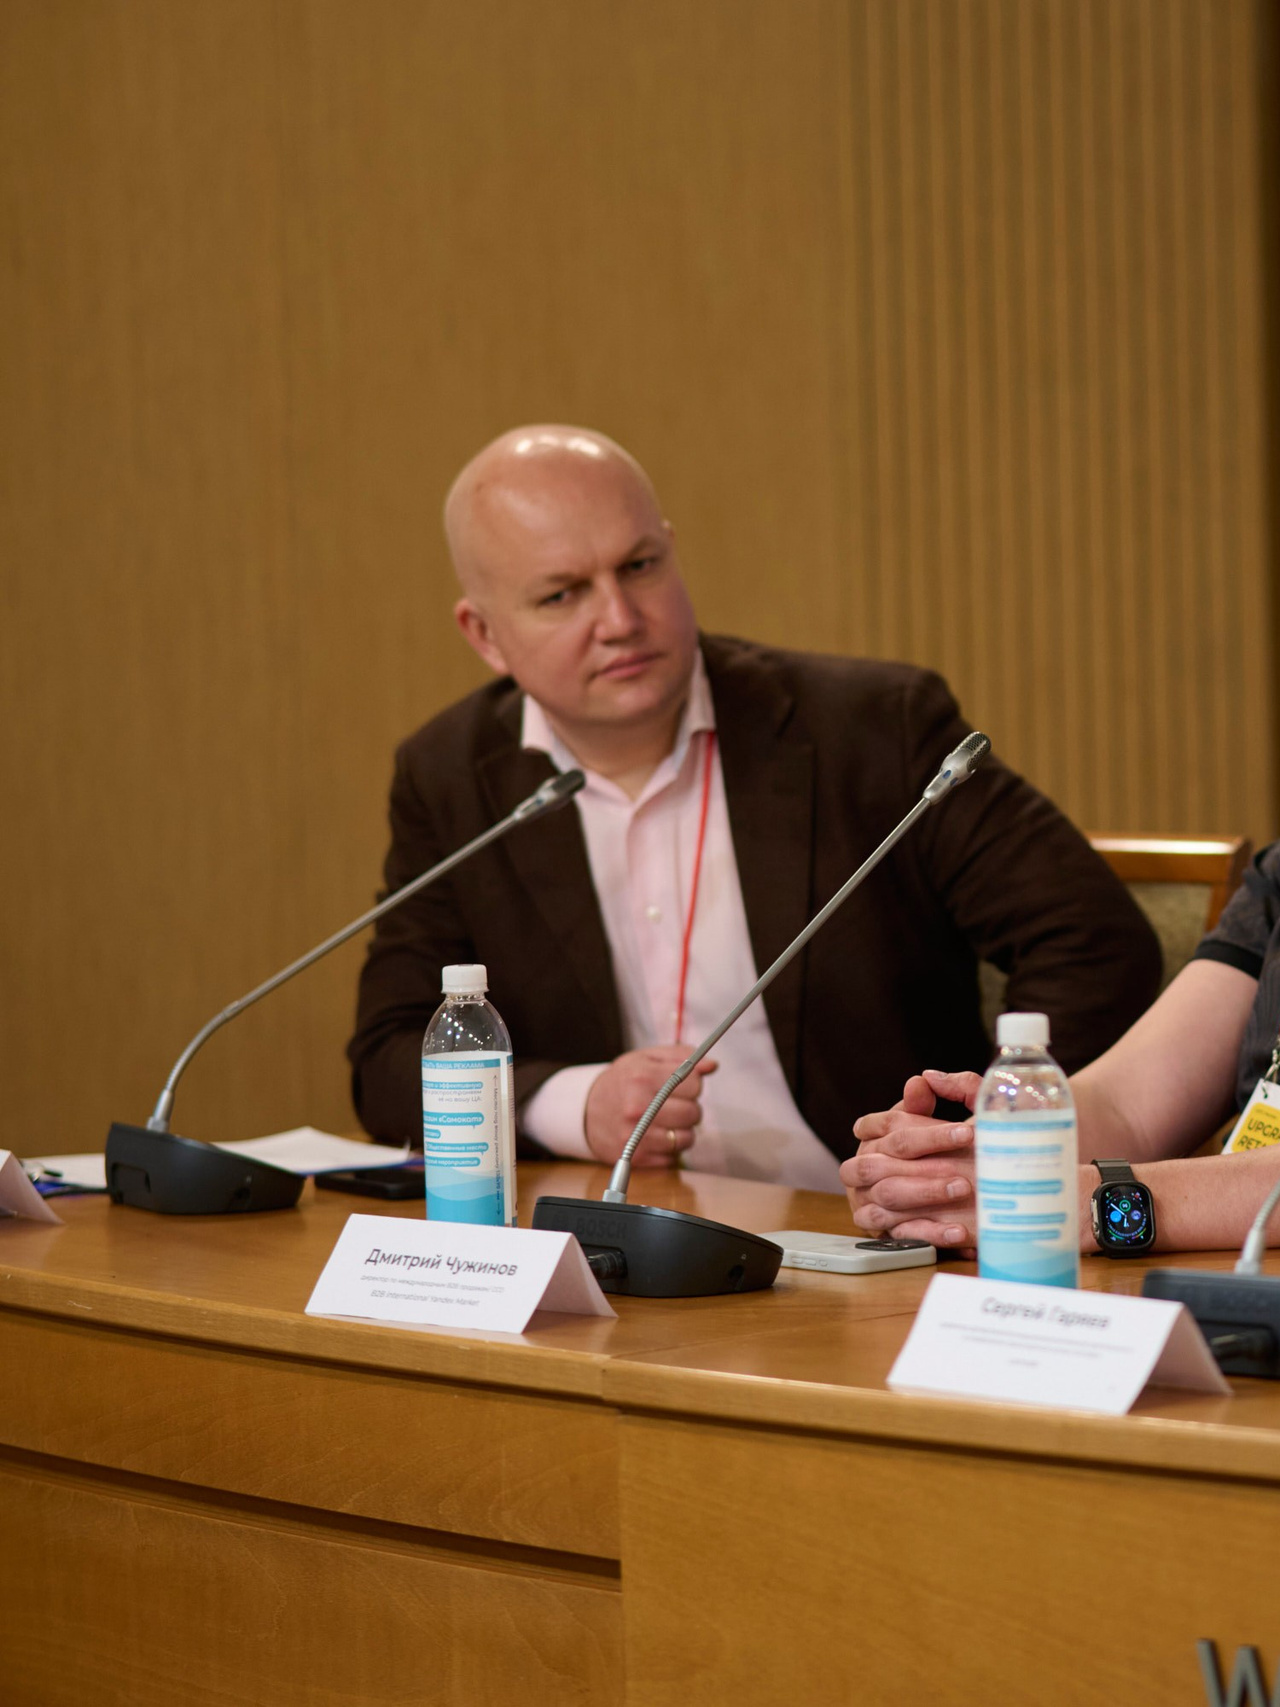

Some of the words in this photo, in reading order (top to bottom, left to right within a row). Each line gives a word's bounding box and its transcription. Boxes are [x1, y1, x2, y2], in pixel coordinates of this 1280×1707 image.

[1237, 1135, 1267, 1150] RET
[576, 1217, 628, 1239] BOSCH
[365, 1248, 442, 1271] Дмитрий
[446, 1254, 519, 1276] Чужинов
